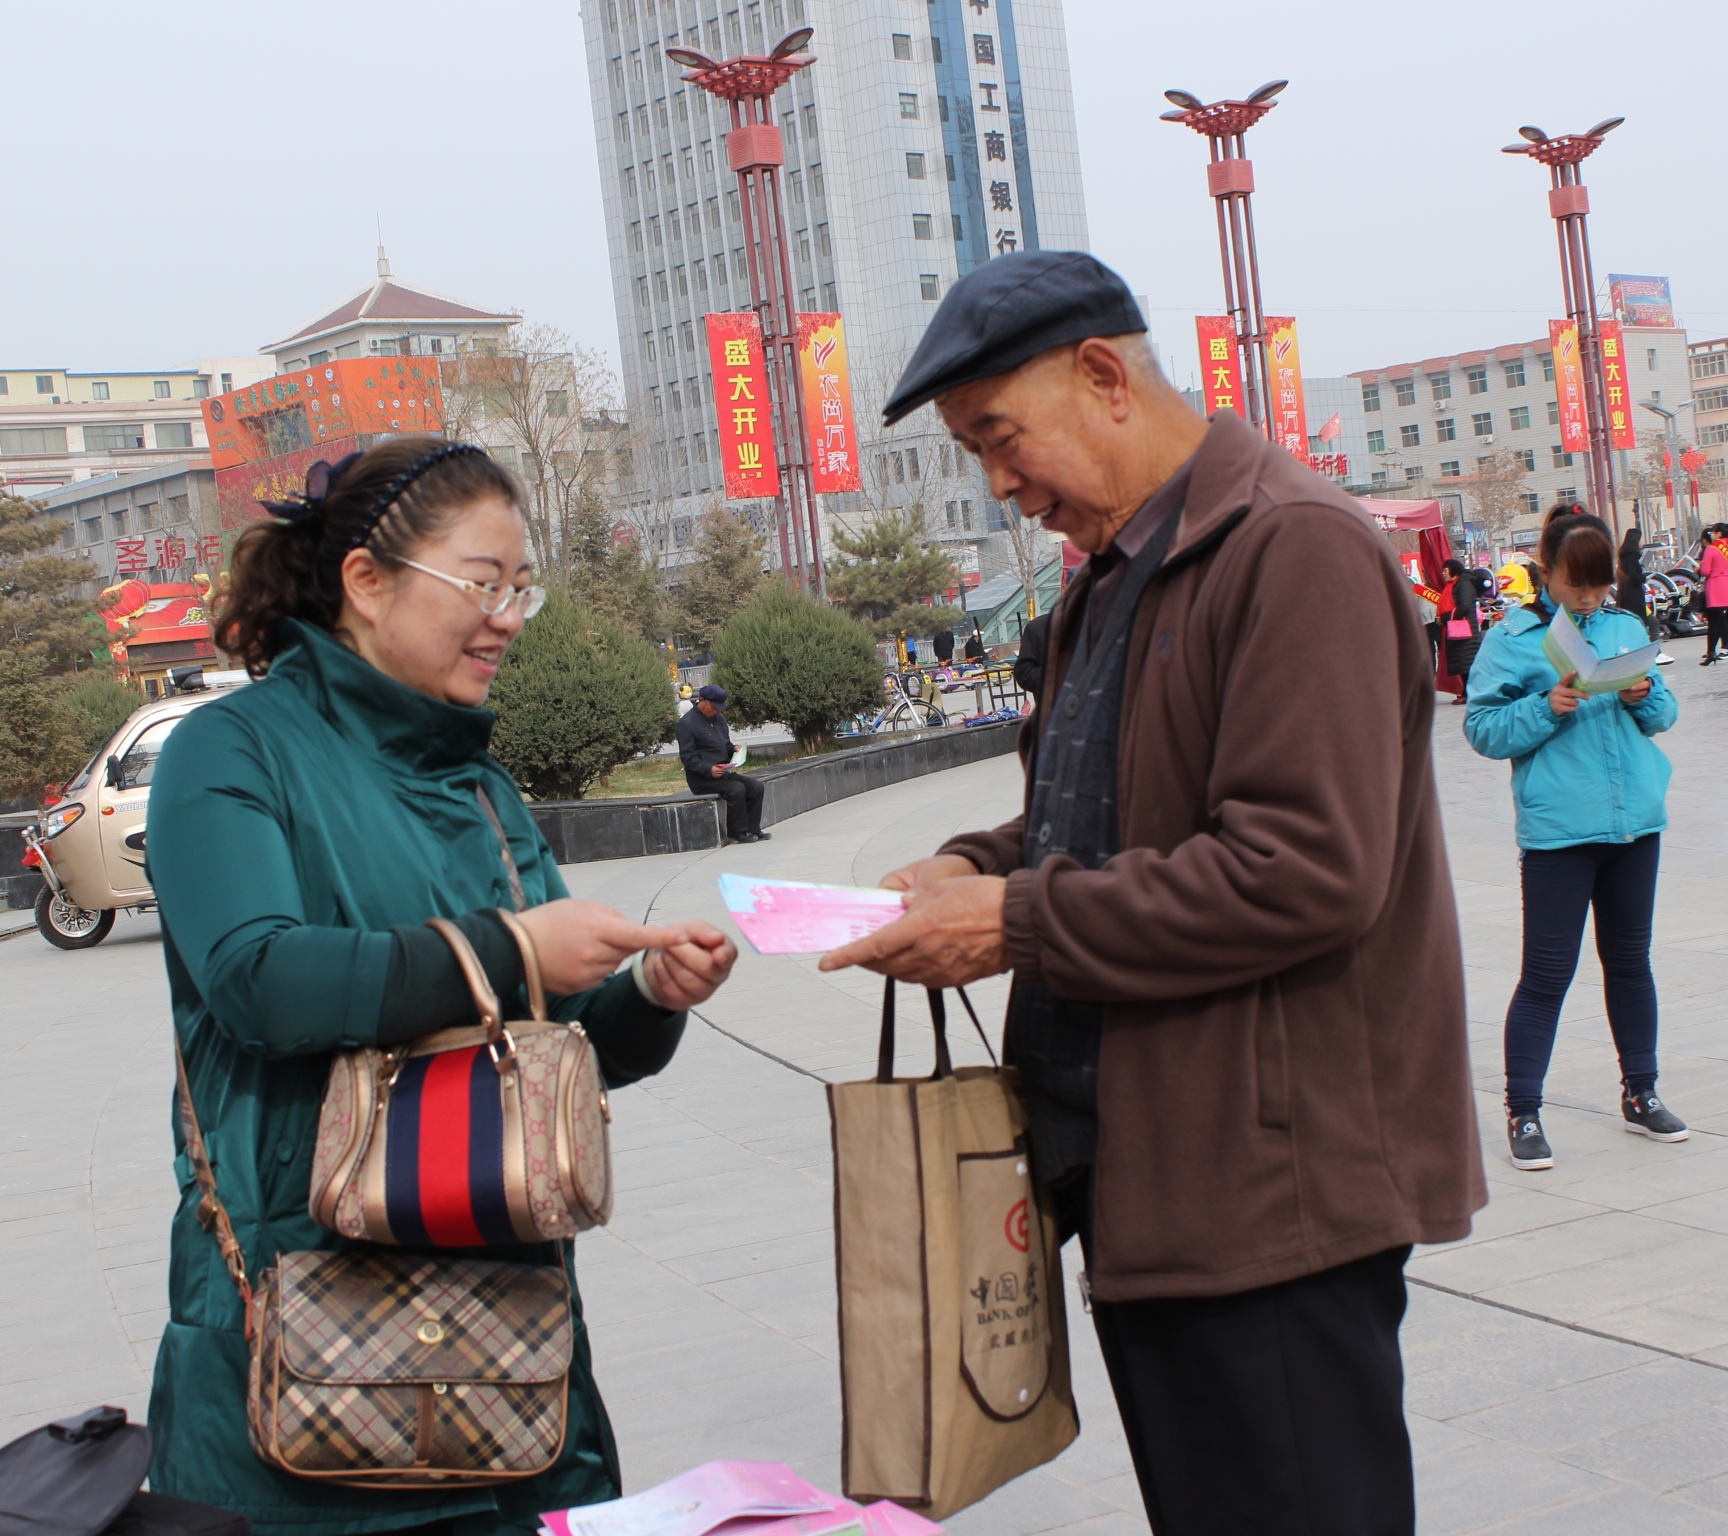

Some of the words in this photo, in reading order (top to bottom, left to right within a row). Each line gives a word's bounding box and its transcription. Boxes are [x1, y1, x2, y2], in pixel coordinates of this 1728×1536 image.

[724, 339, 763, 470] 盛大开业
[819, 374, 850, 475] 衣尚万家
[1278, 368, 1302, 454] 衣尚万家
[1564, 365, 1584, 440] 衣尚万家
[1603, 338, 1627, 430] 盛大开业
[977, 1308, 1012, 1325] BANK
